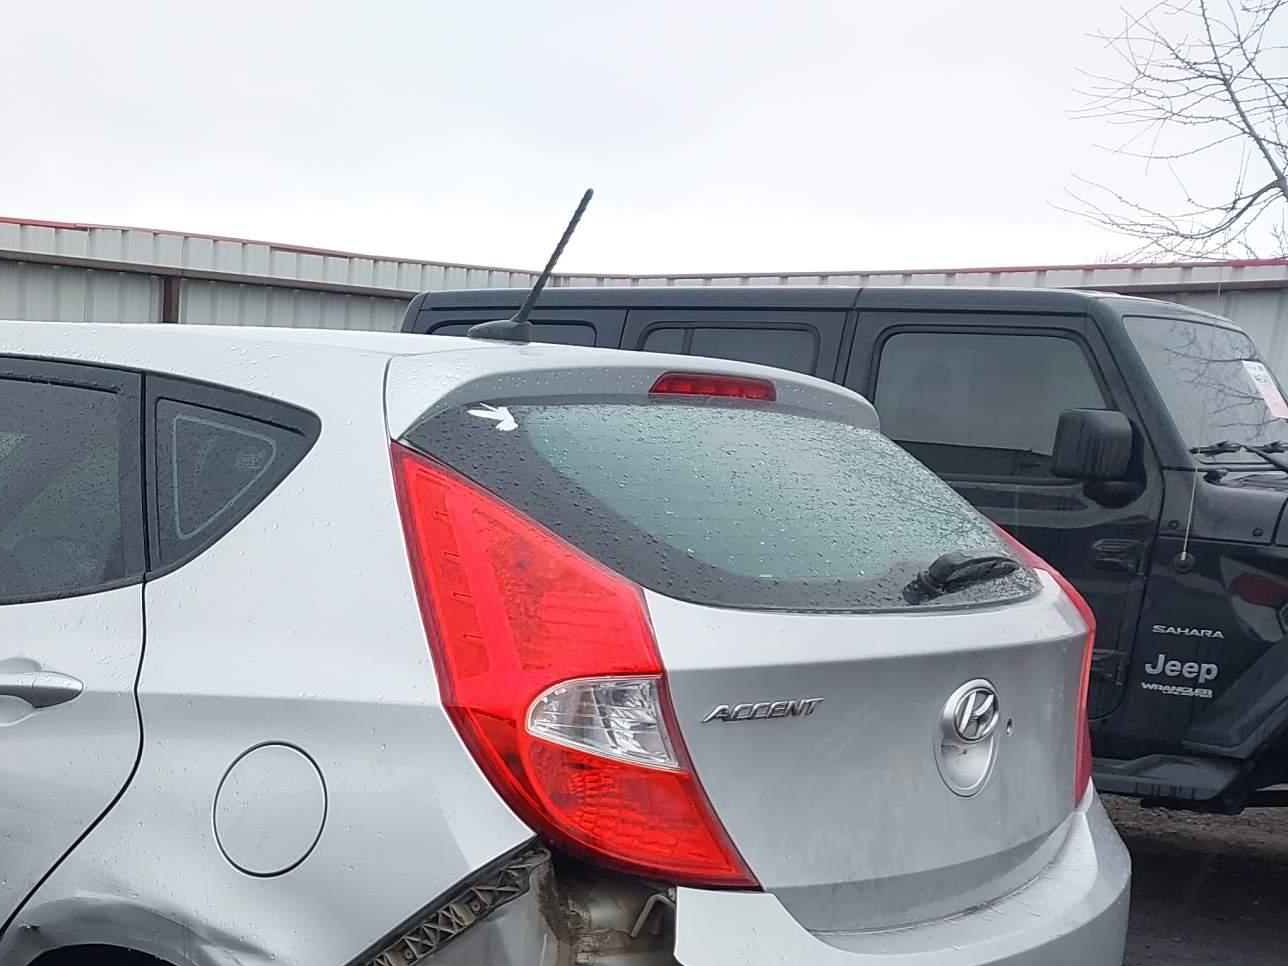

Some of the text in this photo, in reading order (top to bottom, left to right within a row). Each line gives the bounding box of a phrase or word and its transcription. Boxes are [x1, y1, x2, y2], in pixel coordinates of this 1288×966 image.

[1152, 624, 1225, 639] SAHARA
[1144, 653, 1219, 684] Jeep
[700, 697, 825, 723] ACCENT
